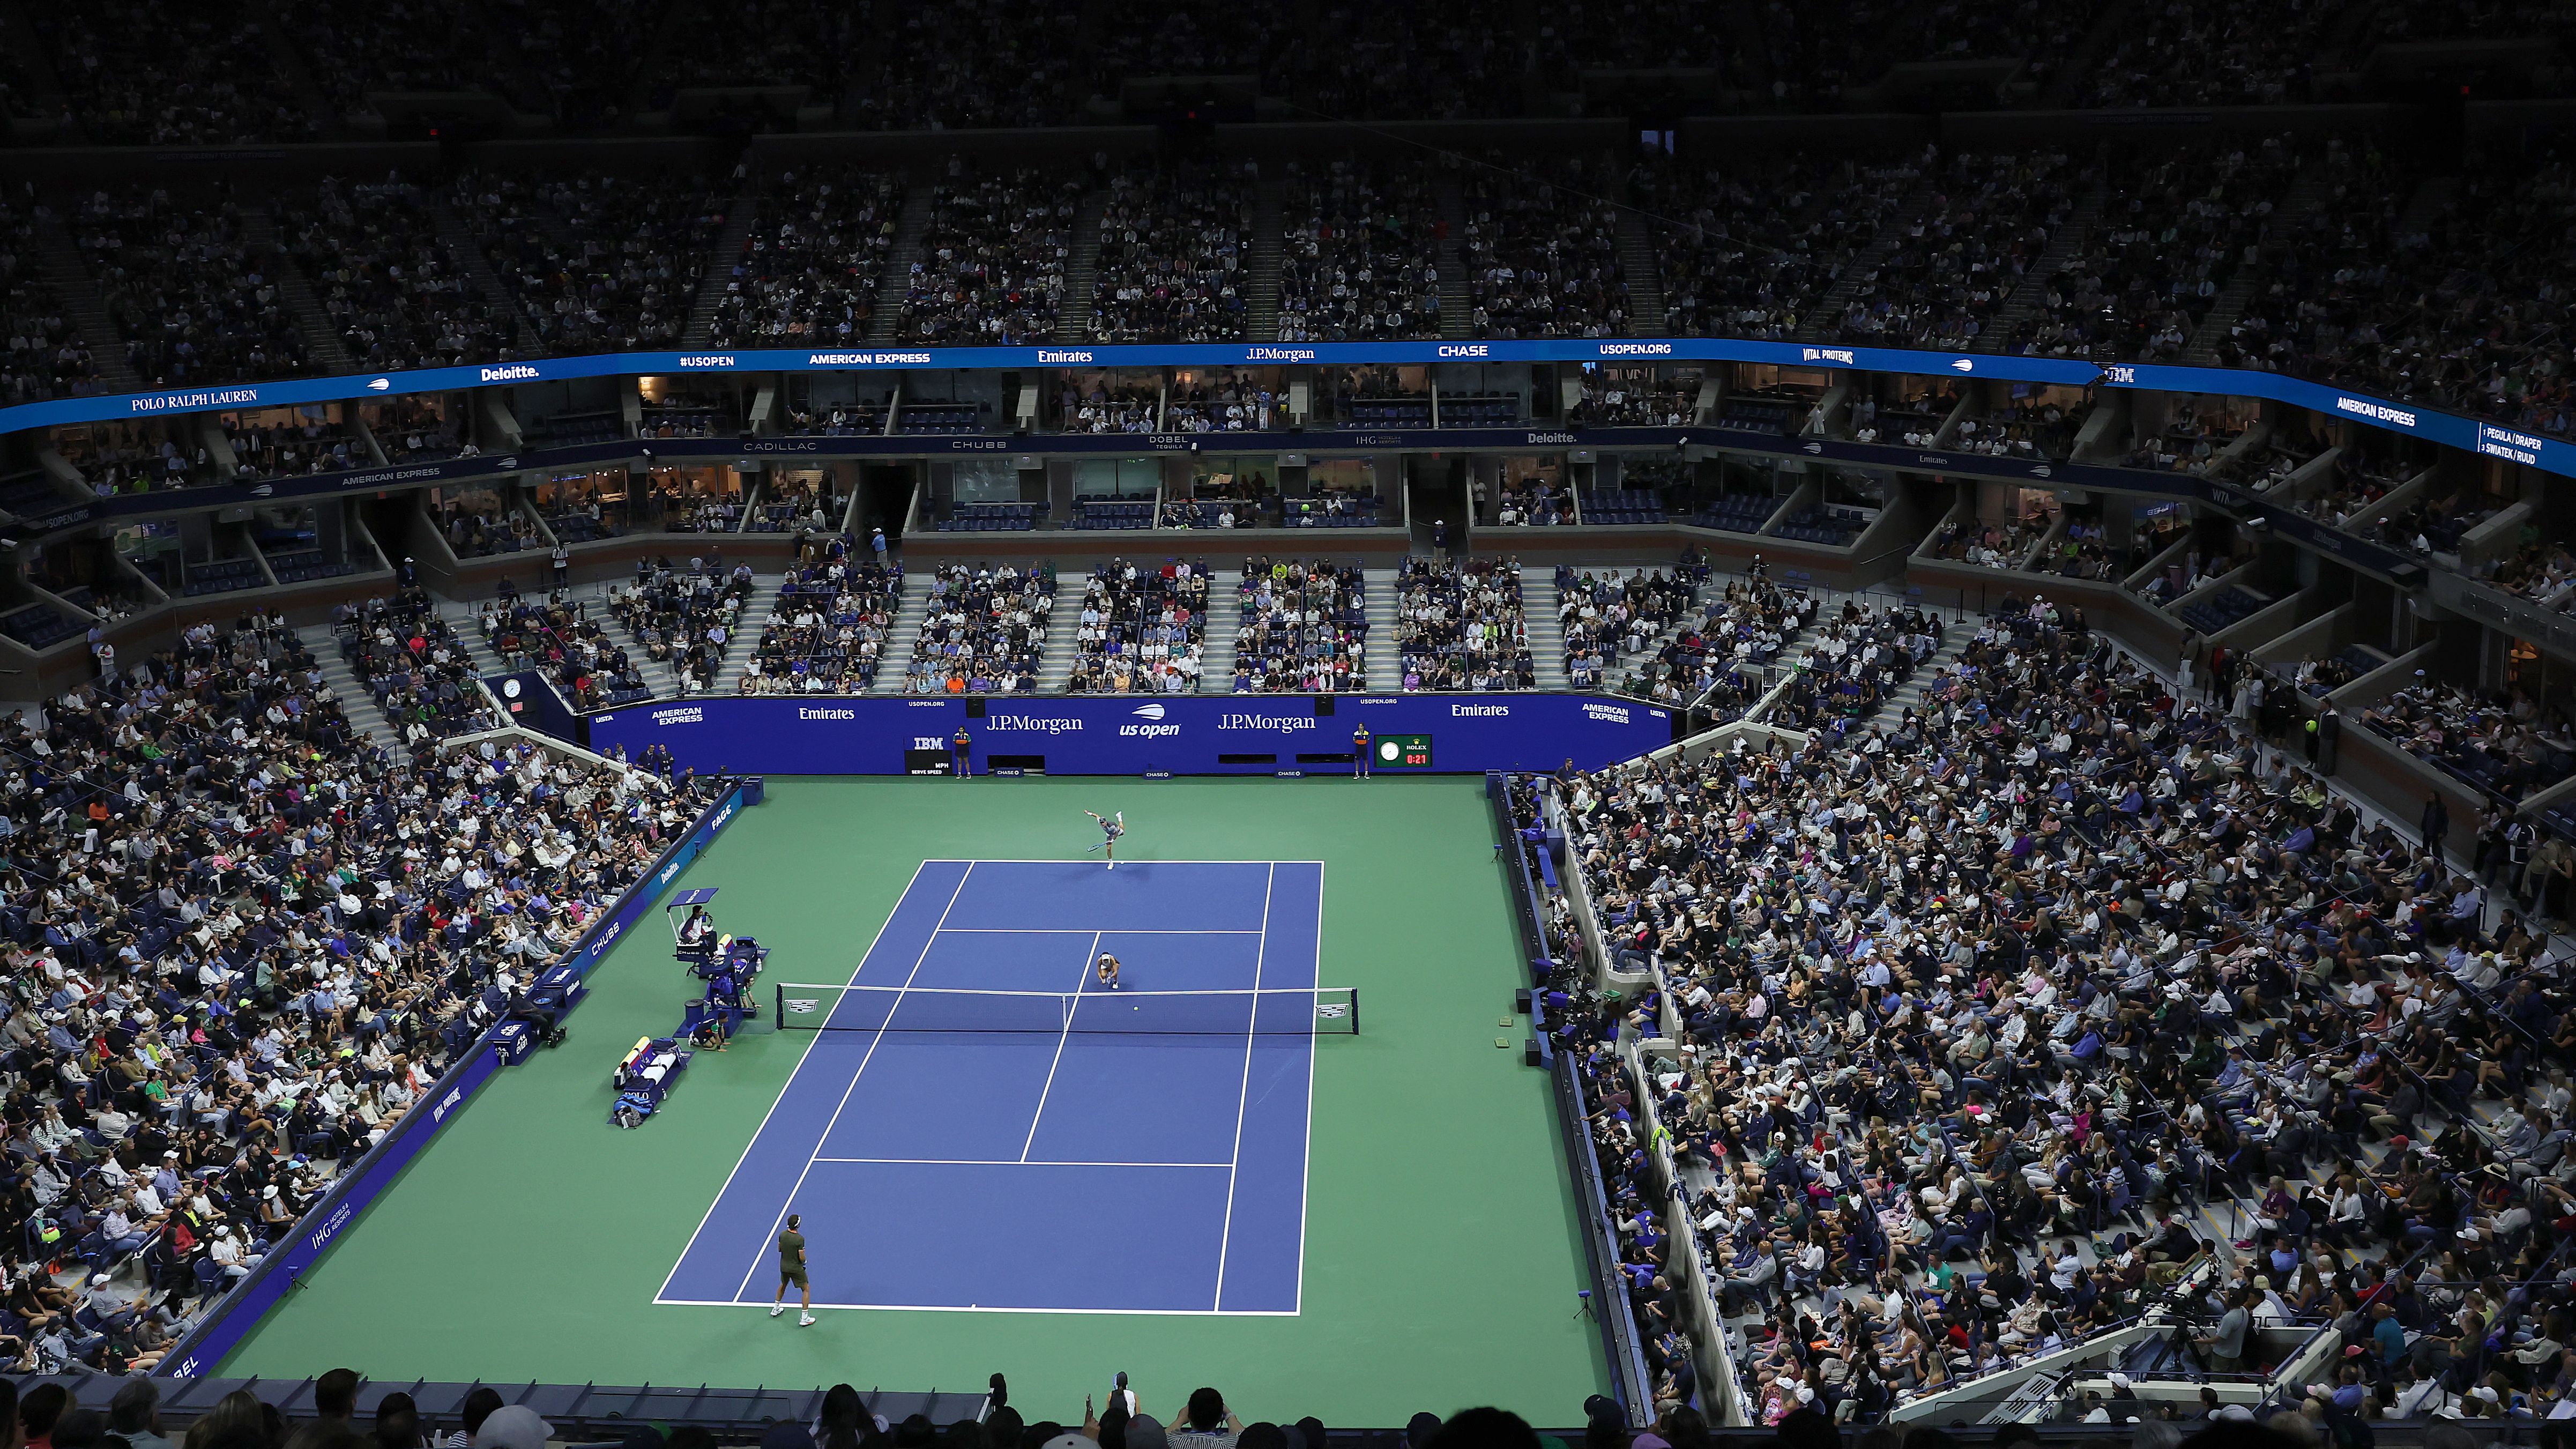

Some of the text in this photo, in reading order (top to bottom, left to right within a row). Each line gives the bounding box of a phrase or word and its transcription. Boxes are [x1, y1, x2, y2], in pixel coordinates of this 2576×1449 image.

[1246, 348, 1315, 362] J.P.Morgan
[1439, 345, 1488, 356] CHASE
[1600, 344, 1671, 354] USOPEN.ORG
[680, 356, 734, 367] #USOPEN
[809, 353, 930, 364] AMERICAN EXPRESS
[1037, 350, 1093, 362] Emirates
[1803, 348, 1853, 365] VITAL PROTEINS
[481, 366, 539, 381] Deloitte.
[2104, 367, 2134, 383] BM
[132, 389, 257, 411] POLO RALPH LAUREN
[2337, 397, 2415, 426] AMERICAN EXPRESS
[1356, 436, 1376, 444] IHG
[1528, 433, 1577, 443] Deloitte.
[743, 442, 816, 451] CADILLAC
[1919, 455, 1947, 464] Emirates
[342, 467, 440, 485] AMERICAN EXPRESS
[651, 707, 702, 720] AMERICAN
[799, 707, 855, 719] Emirates
[1451, 703, 1509, 716] Emirates
[1582, 703, 1629, 716] AMERICAN
[1650, 709, 1666, 718] USTA
[595, 715, 614, 723] USTA
[658, 714, 704, 726] EXPRESS
[1218, 715, 1315, 733] J.P.Morgan
[1589, 711, 1630, 725] EXPRESS
[987, 716, 1083, 734] J.P.Morgan
[914, 737, 944, 750] IBM
[1406, 754, 1426, 764] 0:21
[711, 804, 732, 831] FAGE
[591, 920, 621, 957] CHUBB
[330, 1205, 346, 1225] HOTELS
[331, 1208, 352, 1232] RESORTS
[311, 1221, 331, 1250] IHG
